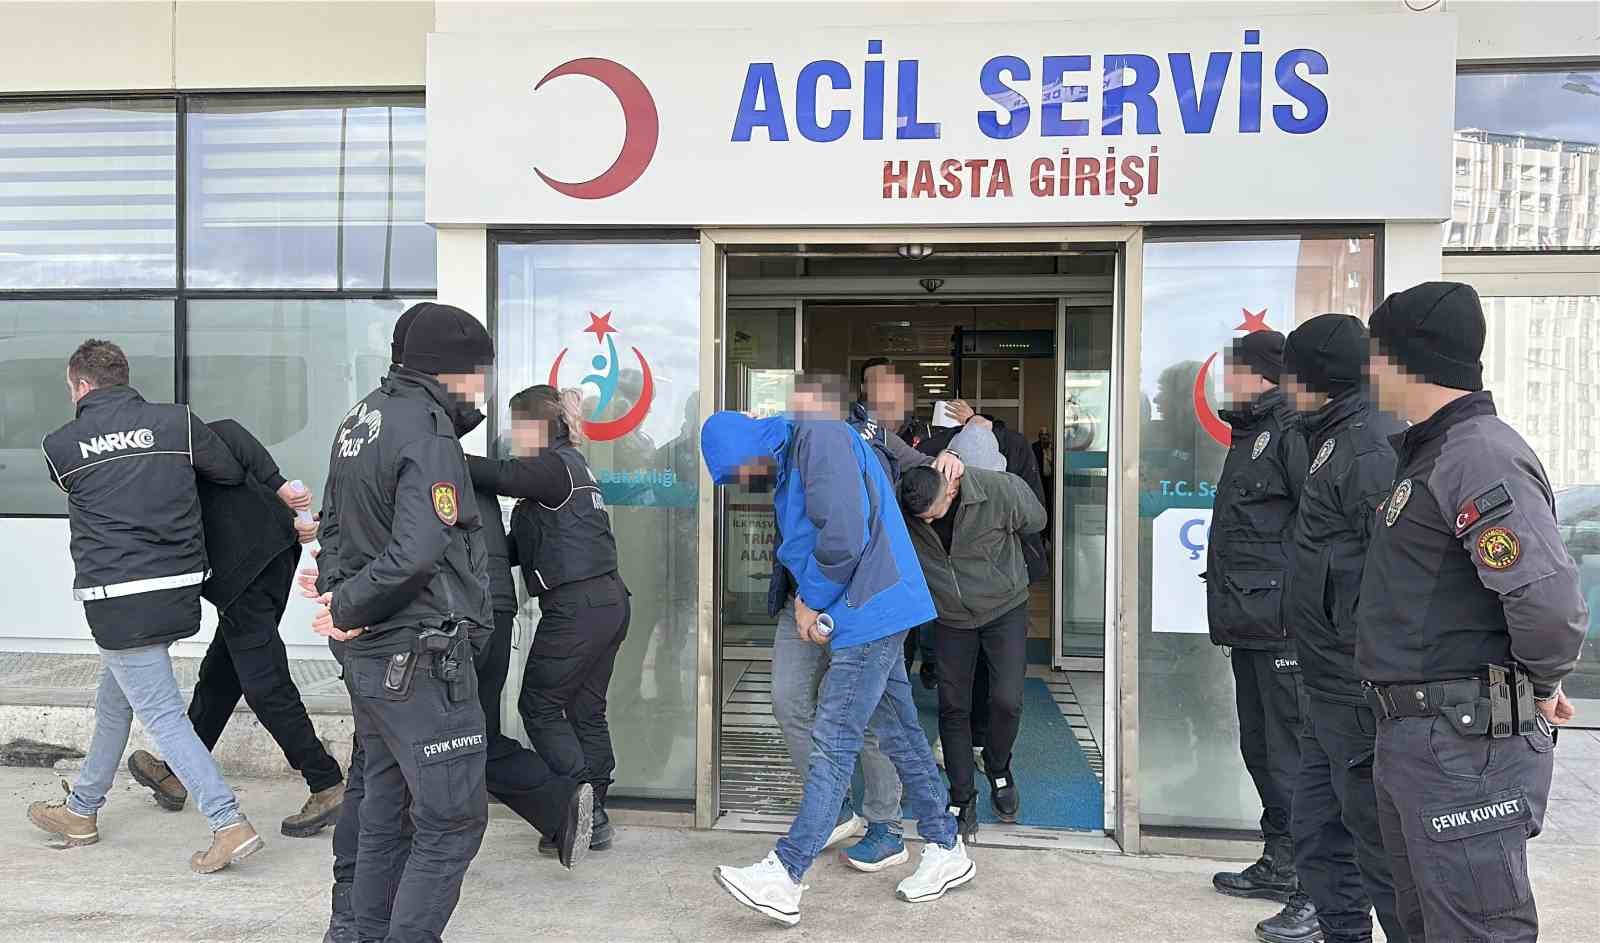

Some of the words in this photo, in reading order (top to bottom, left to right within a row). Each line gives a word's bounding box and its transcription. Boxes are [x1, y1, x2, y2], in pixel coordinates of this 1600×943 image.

[731, 40, 942, 143] ACİL
[977, 30, 1329, 140] SERVİS
[882, 158, 1014, 199] HASTA
[1029, 145, 1160, 207] GİRİŞİ
[78, 428, 156, 459] NARKO
[1159, 480, 1192, 497] T.C.
[1179, 518, 1212, 560] Ç
[452, 735, 482, 748] KUVVET
[1470, 800, 1519, 822] KUVVET
